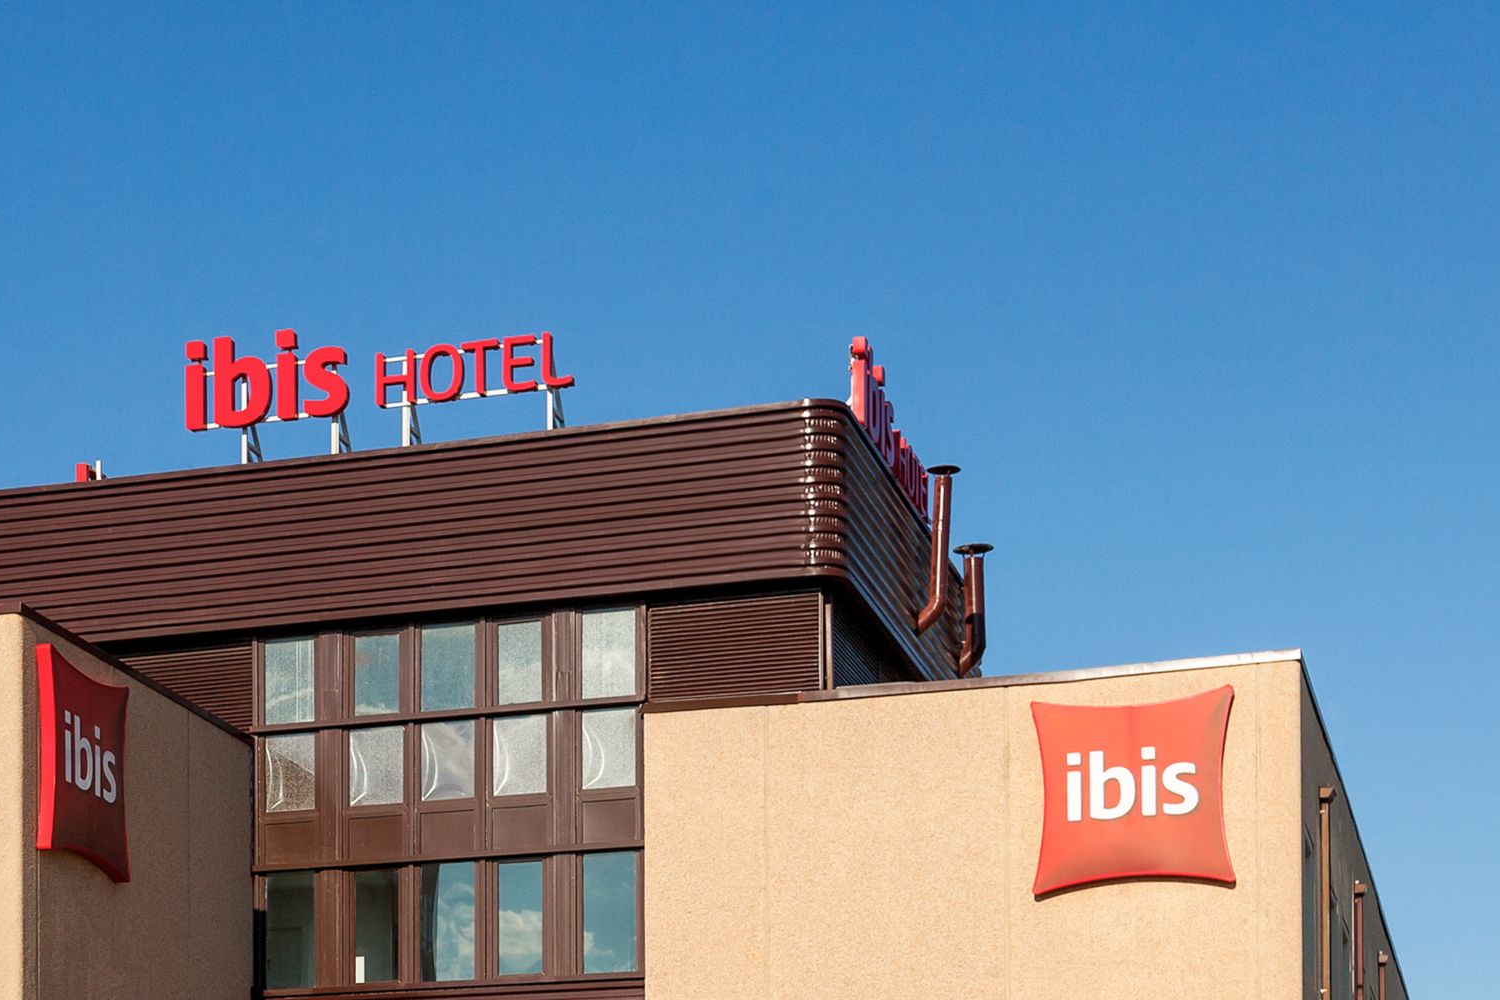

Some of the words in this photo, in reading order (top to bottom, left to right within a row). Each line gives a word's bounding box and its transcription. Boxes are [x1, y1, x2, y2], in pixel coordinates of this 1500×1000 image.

[185, 328, 350, 432] ibis
[375, 331, 575, 409] HOTEL
[64, 709, 117, 804] ibis
[1066, 746, 1200, 822] ibis
